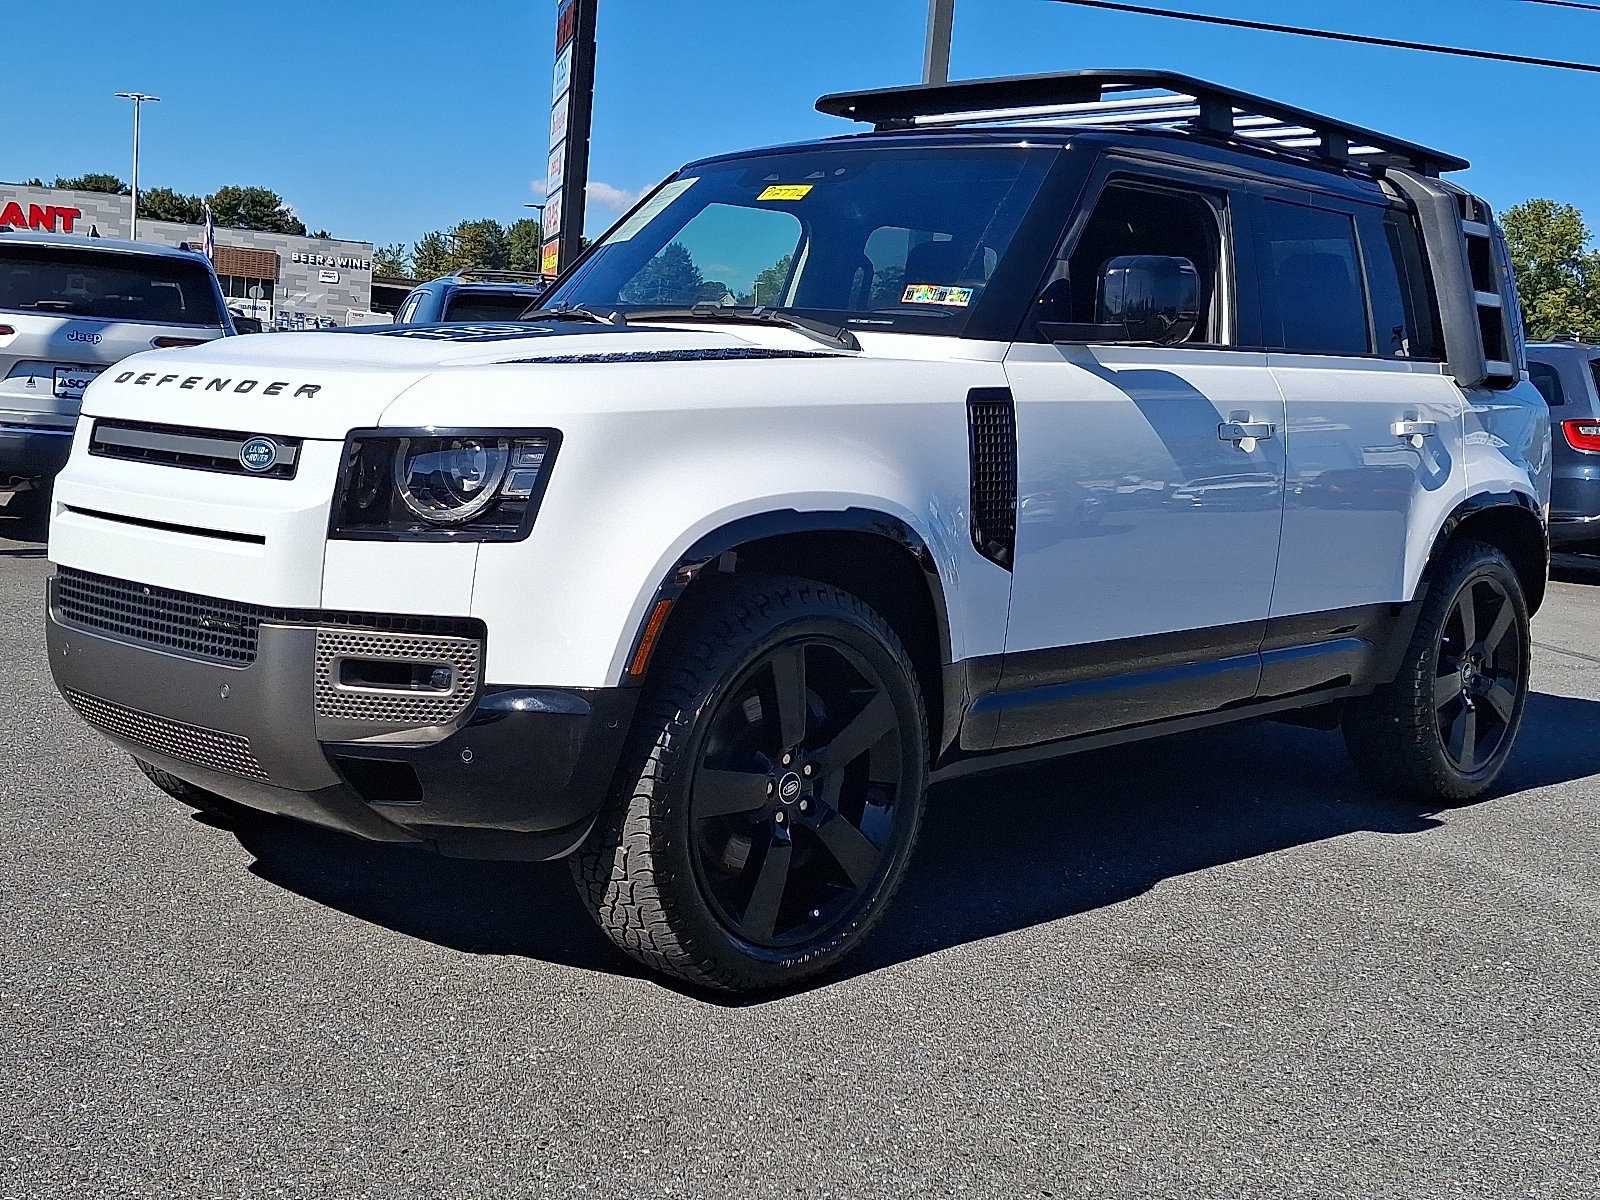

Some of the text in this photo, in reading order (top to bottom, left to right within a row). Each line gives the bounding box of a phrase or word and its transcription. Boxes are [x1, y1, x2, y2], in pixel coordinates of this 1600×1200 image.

[291, 252, 370, 270] BEER & WINE
[66, 329, 104, 345] Jeep
[114, 371, 322, 399] DEFENDER
